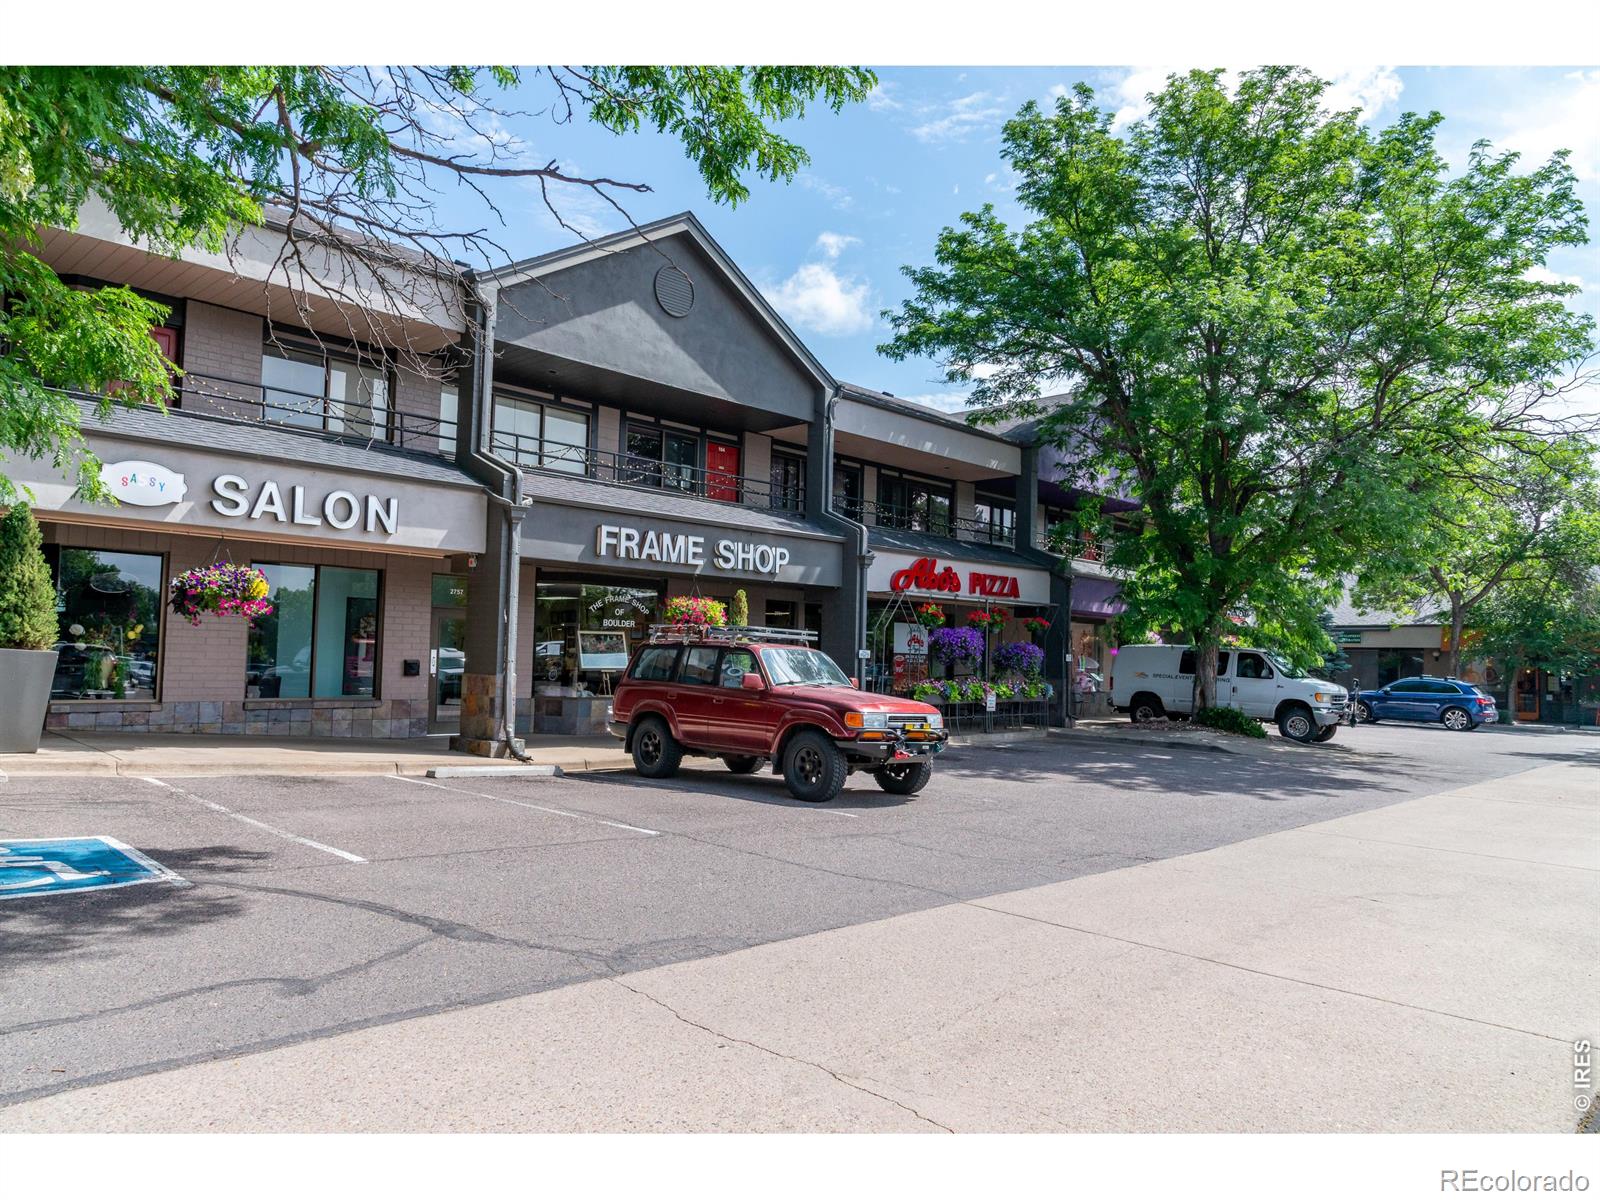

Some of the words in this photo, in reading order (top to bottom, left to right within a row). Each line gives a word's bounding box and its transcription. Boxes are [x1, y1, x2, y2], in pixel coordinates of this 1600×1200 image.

[121, 473, 165, 492] SASY
[211, 474, 399, 535] SALON
[597, 524, 705, 565] FRAME
[713, 539, 790, 574] SHOP
[969, 572, 1020, 598] PIZZA
[589, 599, 604, 613] THE
[605, 594, 630, 604] FRAME
[631, 599, 650, 615] SHOP
[614, 608, 625, 616] OF
[602, 619, 636, 628] BOULDER
